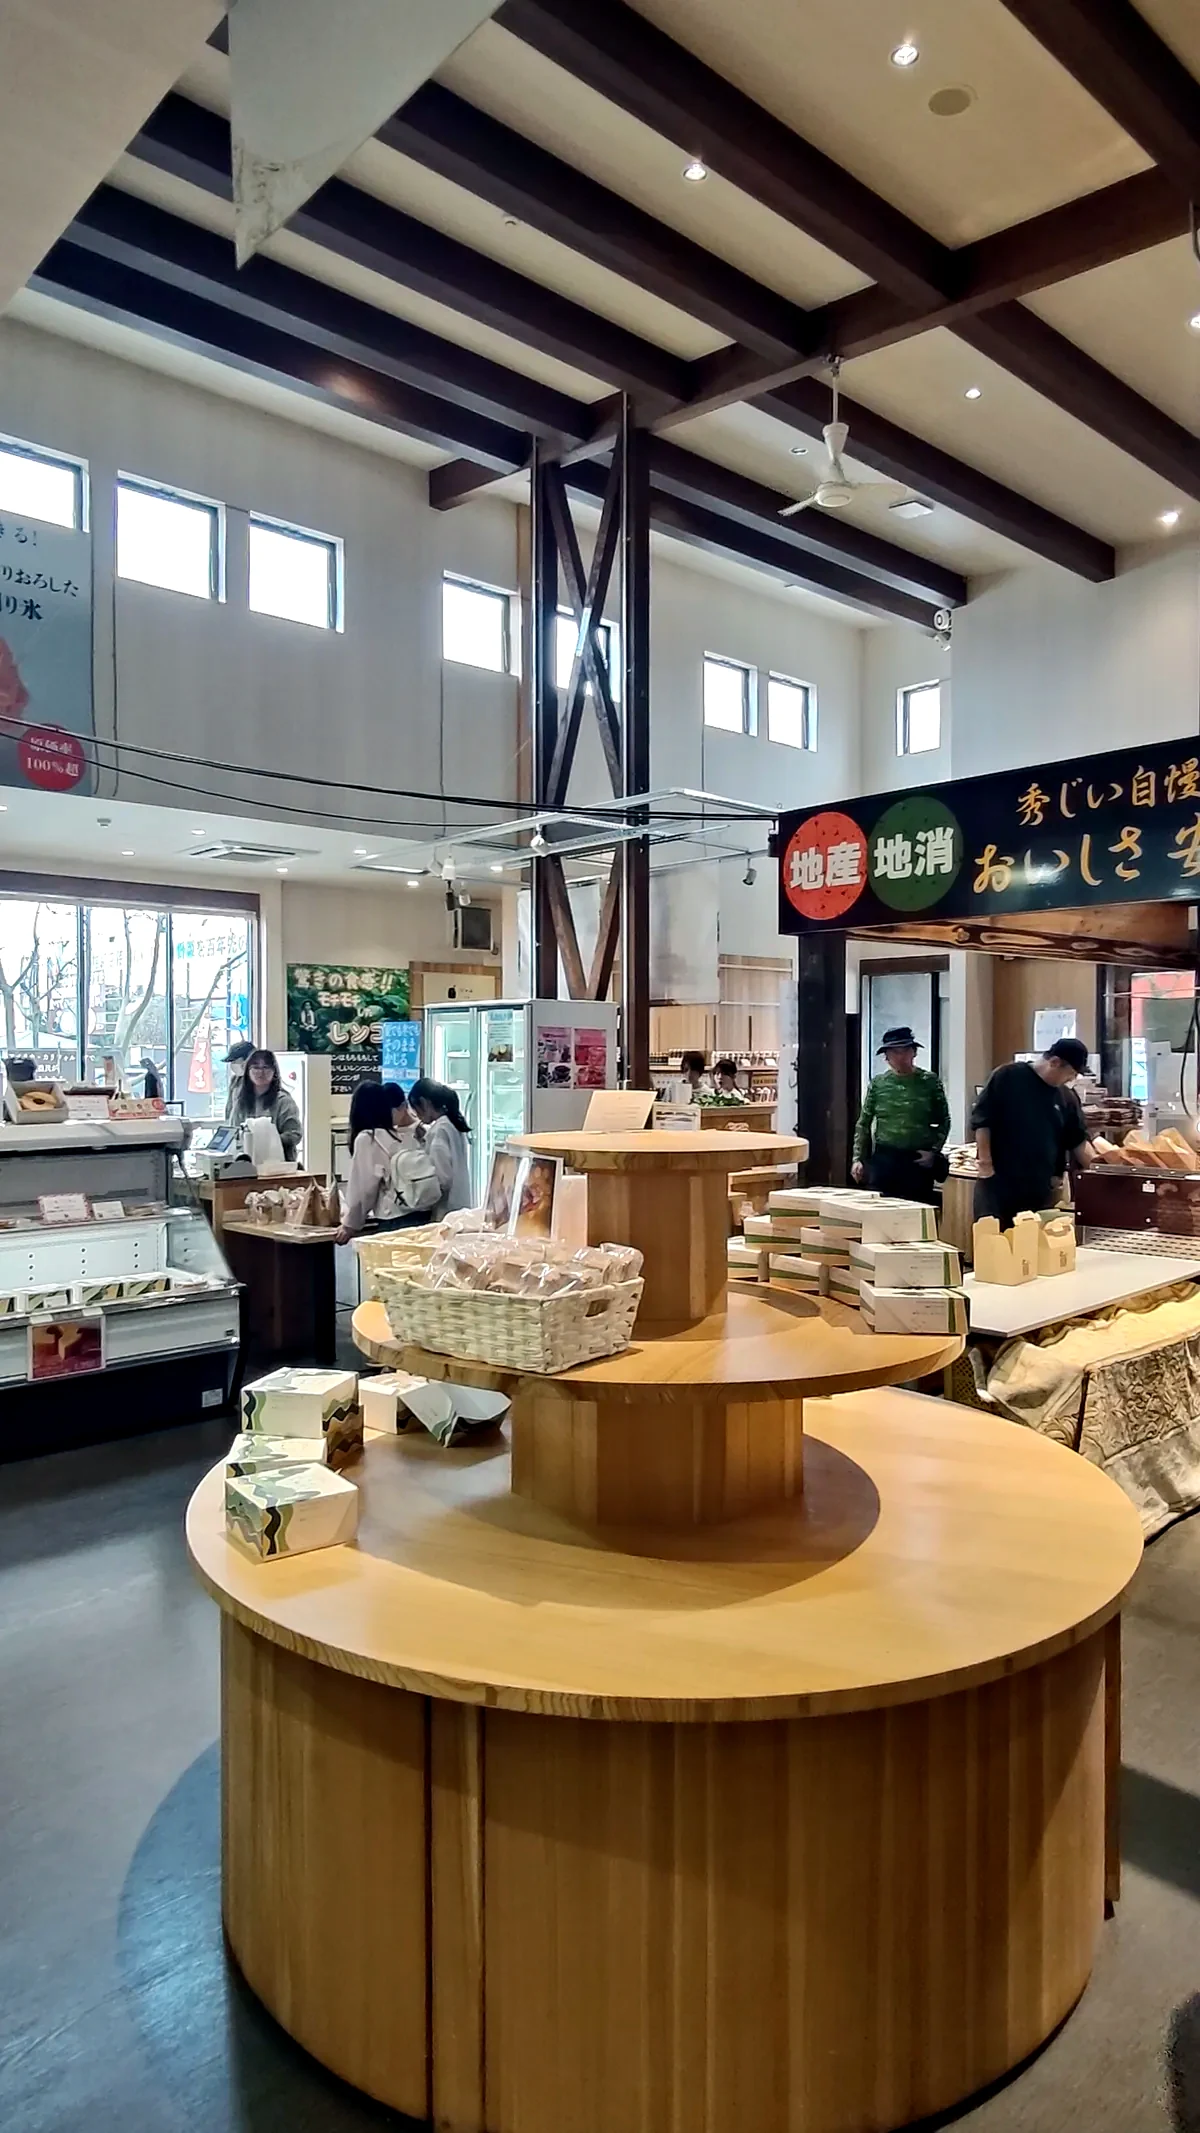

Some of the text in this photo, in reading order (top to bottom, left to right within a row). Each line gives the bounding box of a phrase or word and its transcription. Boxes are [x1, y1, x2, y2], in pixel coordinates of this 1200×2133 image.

[0, 592, 43, 620] り氷
[1016, 757, 1200, 826] 秀じい自慢
[789, 826, 955, 891] 地産 地消
